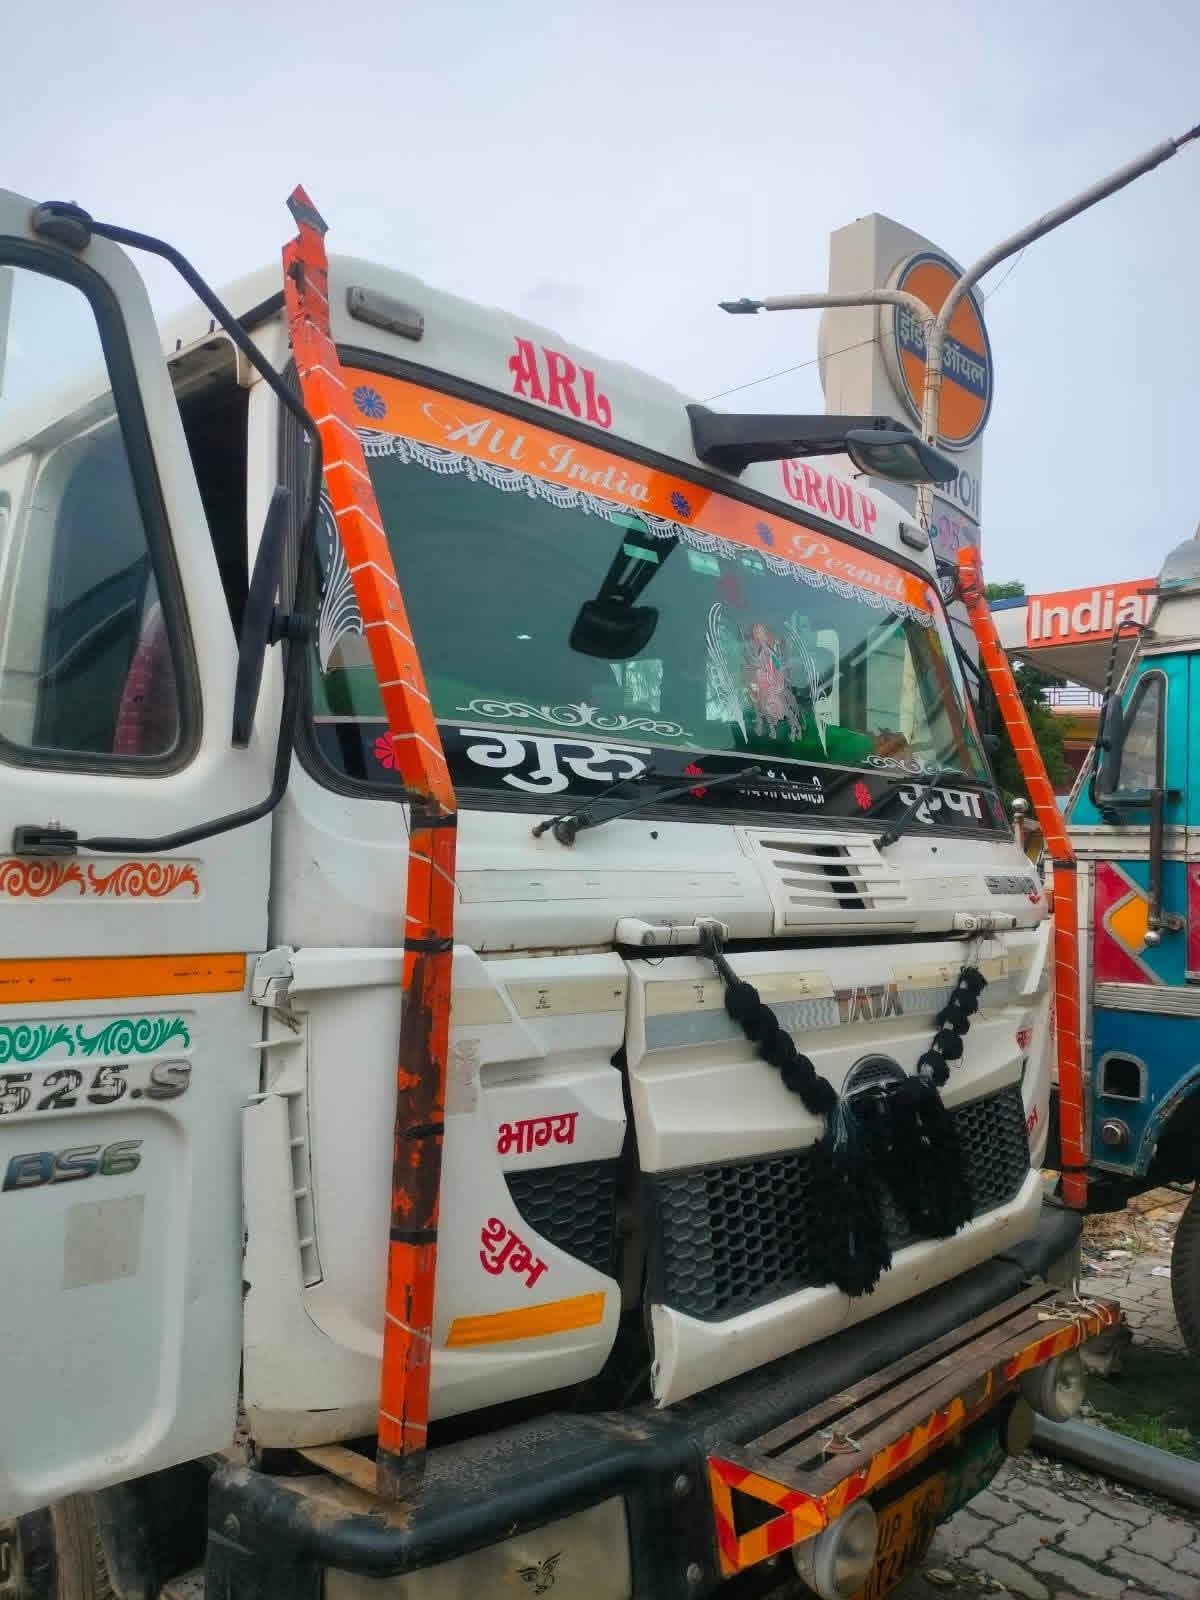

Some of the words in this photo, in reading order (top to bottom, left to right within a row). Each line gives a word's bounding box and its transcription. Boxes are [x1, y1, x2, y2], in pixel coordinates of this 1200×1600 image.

[509, 336, 612, 428] ARL
[781, 458, 877, 534] GROUP
[422, 402, 525, 460] All
[539, 443, 650, 501] India
[790, 534, 905, 594] Permit
[2, 1140, 144, 1192] BS6
[497, 1112, 579, 1154] भाग्य
[480, 1217, 549, 1289] शुभ
